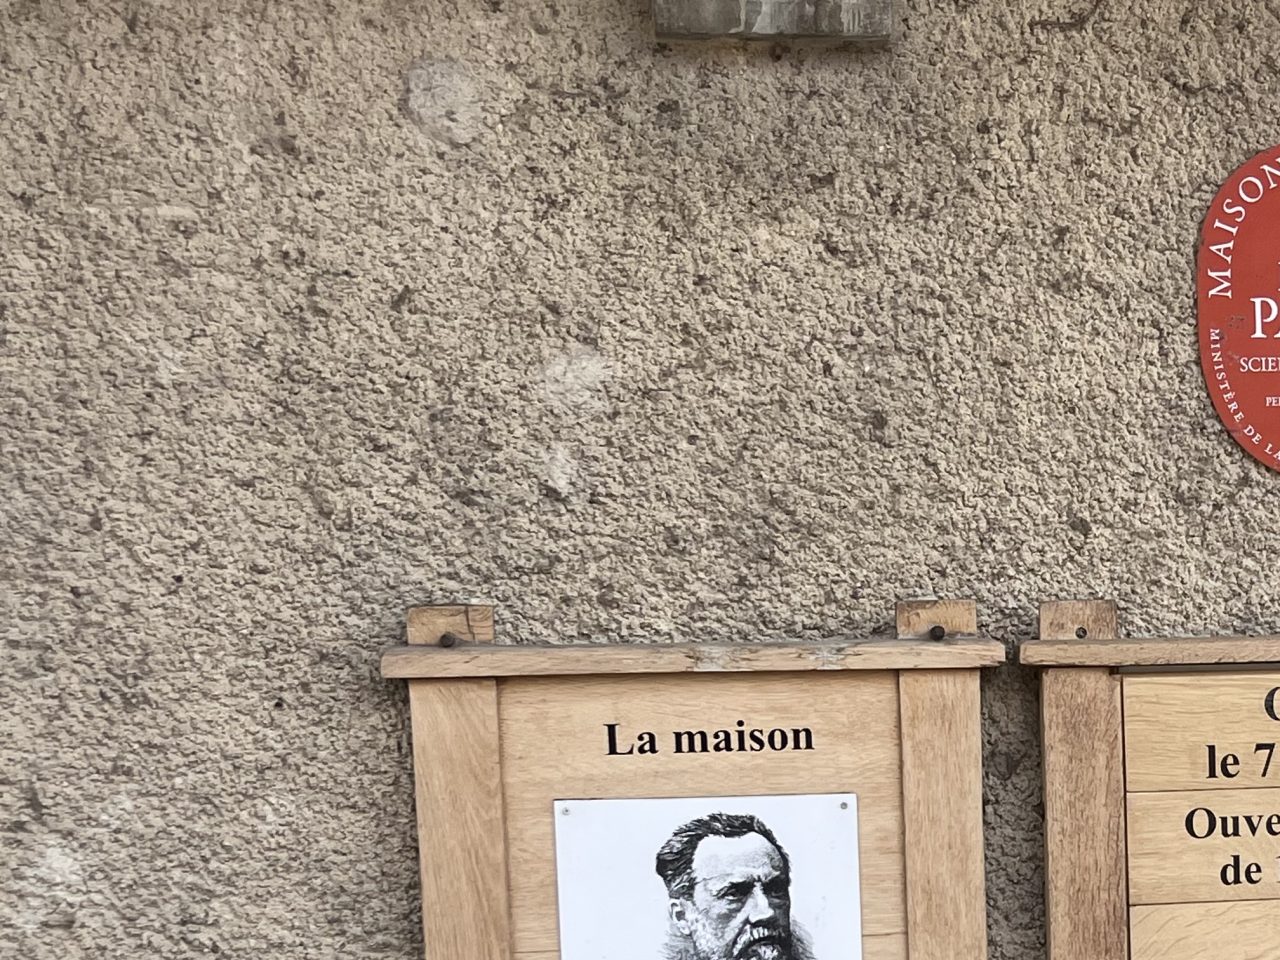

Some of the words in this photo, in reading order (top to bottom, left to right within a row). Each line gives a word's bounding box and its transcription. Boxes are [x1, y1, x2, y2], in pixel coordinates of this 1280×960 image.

[1210, 327, 1245, 424] MINISTÈRE
[1243, 424, 1262, 446] DE
[603, 722, 659, 756] La
[672, 719, 815, 754] maison
[1206, 743, 1241, 779] le
[1254, 742, 1276, 777] 7
[1220, 853, 1262, 886] de
